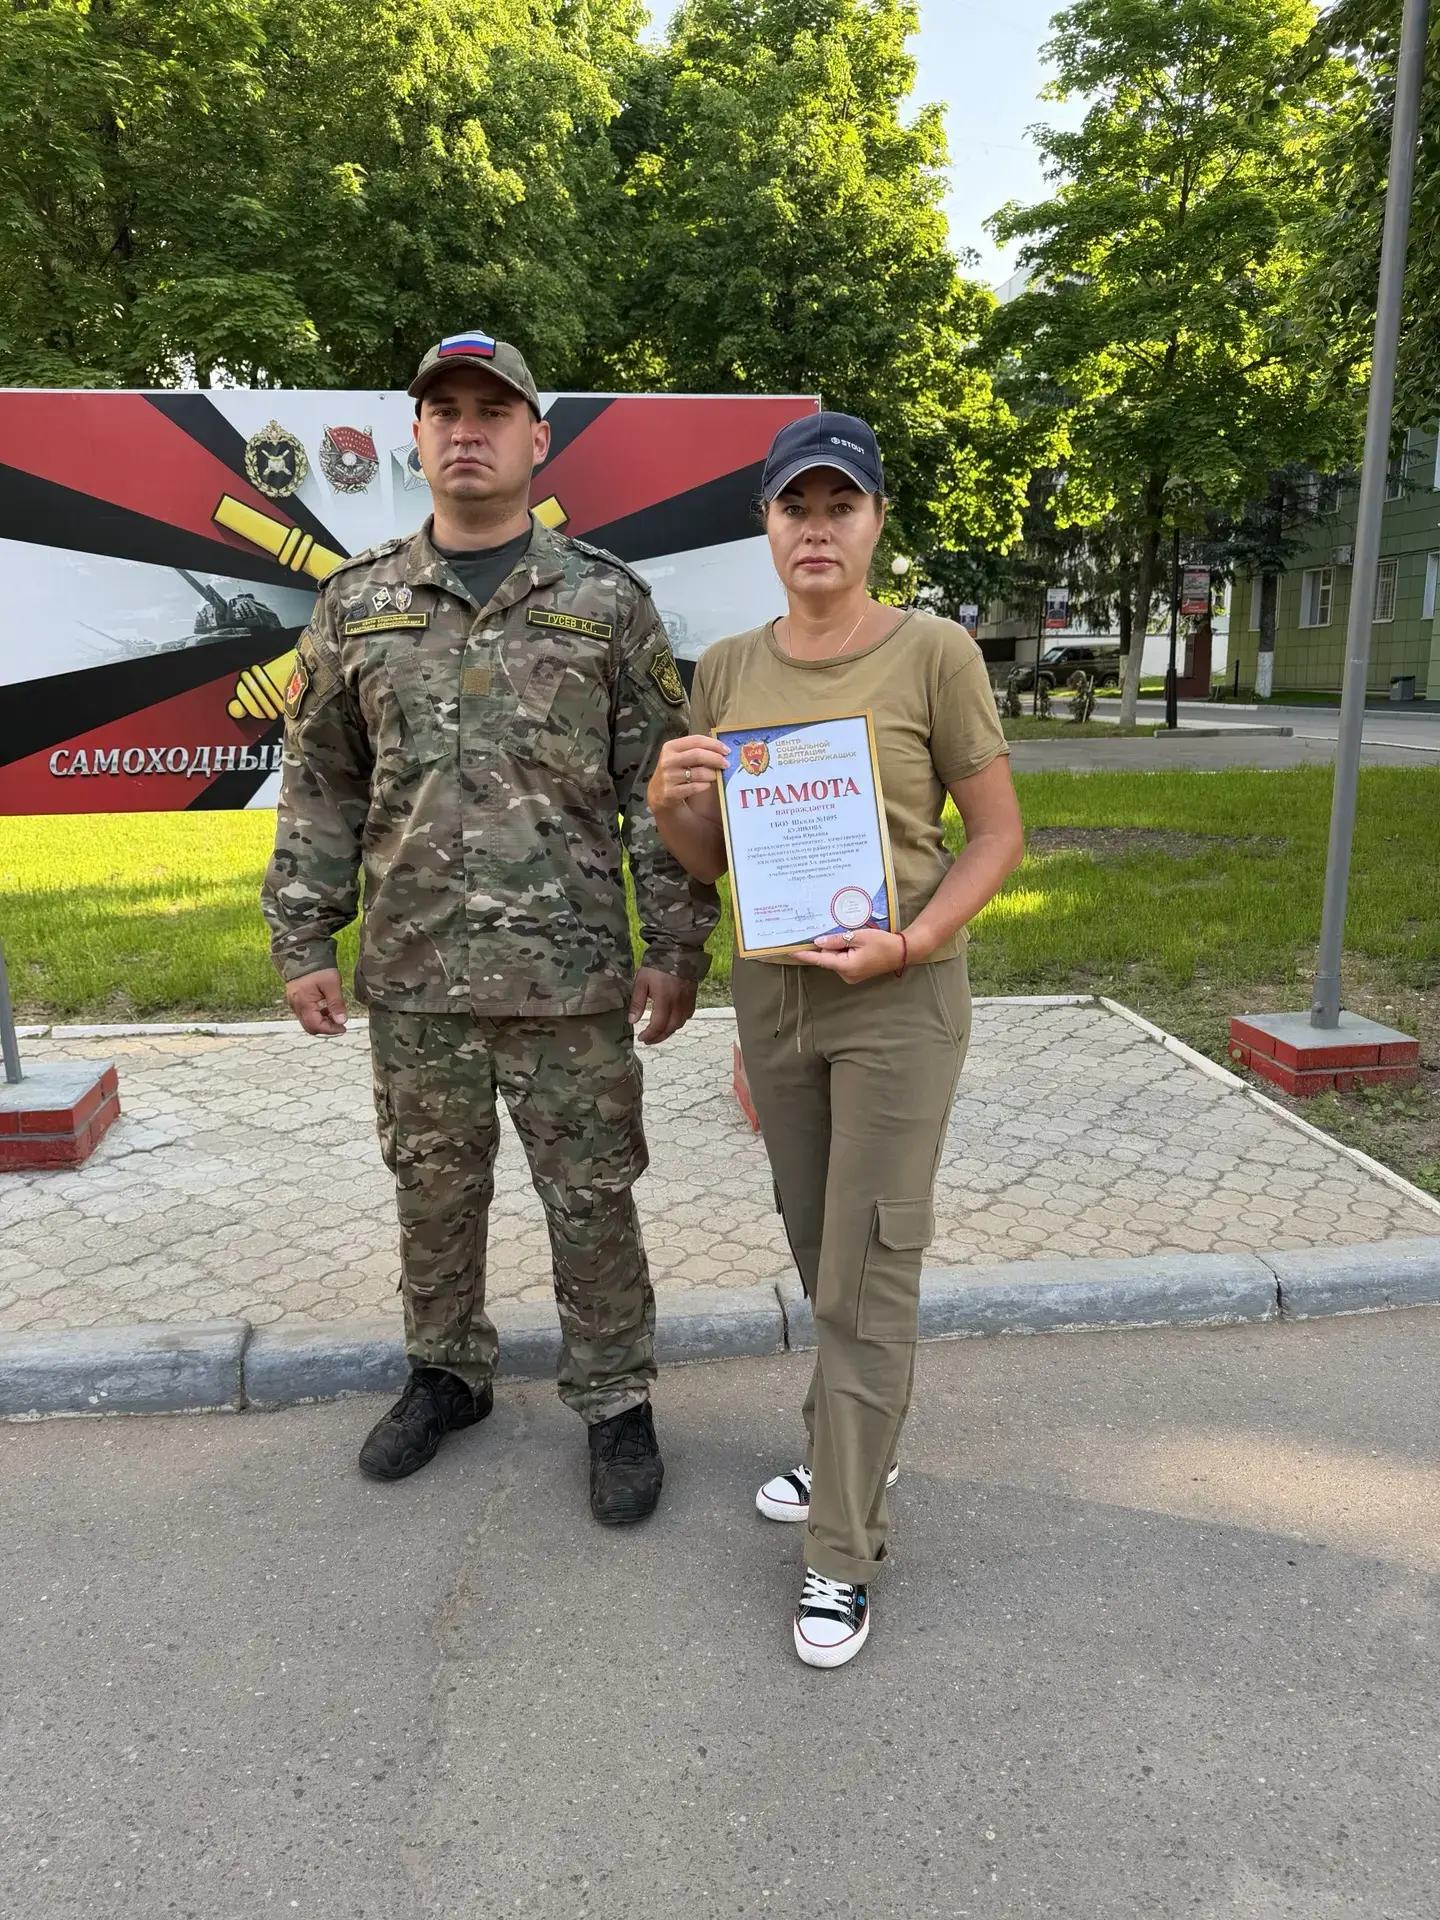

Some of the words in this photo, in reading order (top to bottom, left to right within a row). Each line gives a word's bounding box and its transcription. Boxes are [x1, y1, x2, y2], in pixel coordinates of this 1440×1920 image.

[841, 439, 865, 455] STOUT
[547, 614, 577, 629] ГУСЕВ
[581, 621, 598, 634] К.Г.
[775, 739, 801, 747] ЦЕНТР
[776, 740, 831, 753] СОЦИАЛЬНОЙ
[777, 749, 826, 759] АДАПТАЦИИ
[777, 751, 857, 766] ВОЕННОСЛУЖАЩИХ
[739, 776, 861, 809] ГРАМОТА
[775, 803, 836, 816] награждается
